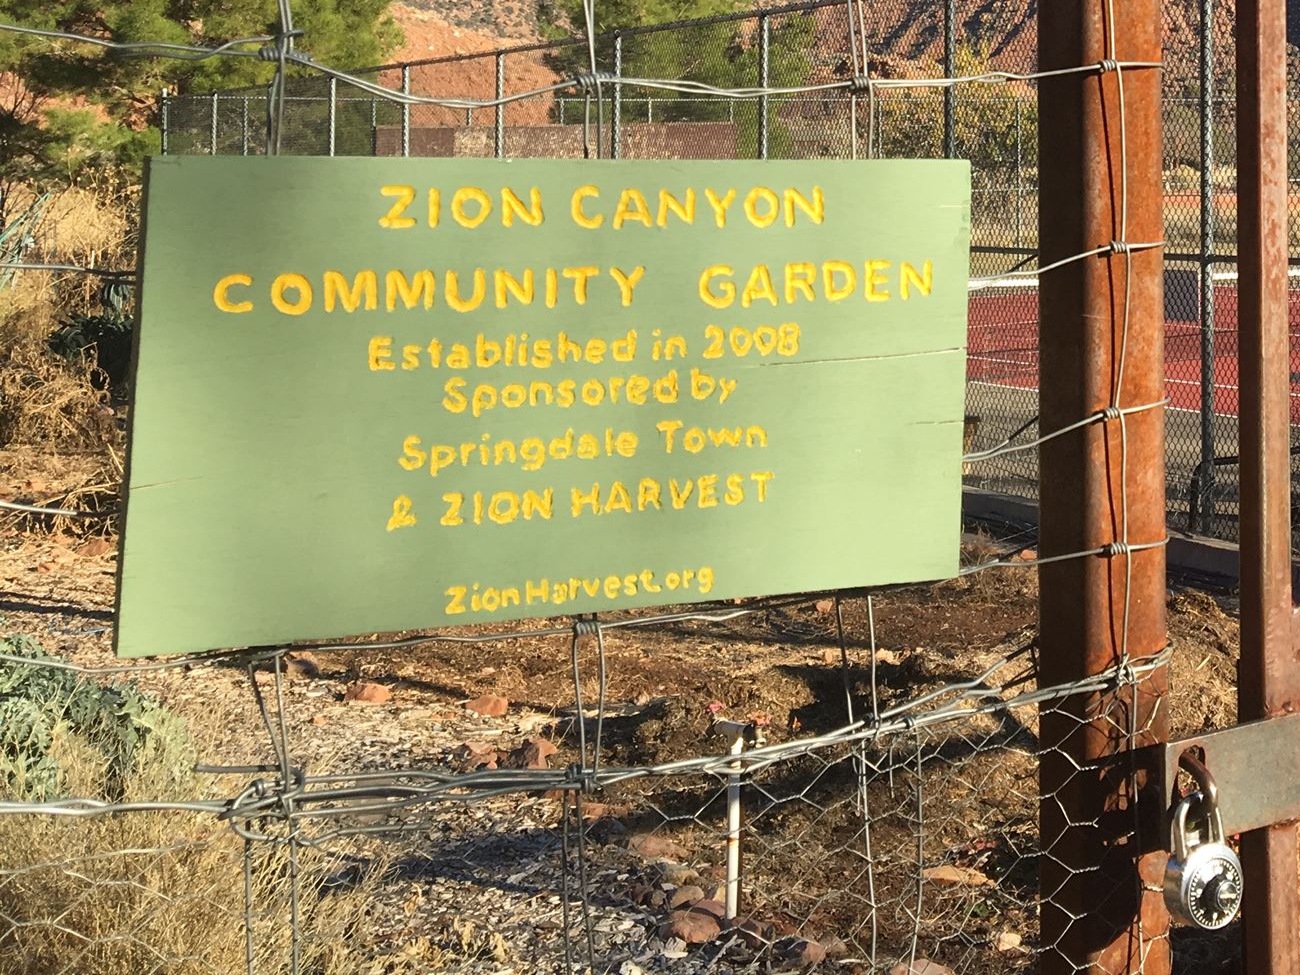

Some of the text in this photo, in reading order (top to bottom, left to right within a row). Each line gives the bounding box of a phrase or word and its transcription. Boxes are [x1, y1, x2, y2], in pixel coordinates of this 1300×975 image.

[379, 184, 824, 229] ZION CANYON
[212, 259, 932, 316] COMMUNITY GARDEN
[368, 323, 800, 370] Established in 2008
[443, 368, 736, 417] Sponsored by
[399, 420, 768, 476] Springdale Town
[386, 472, 773, 531] & ZION HARVEST
